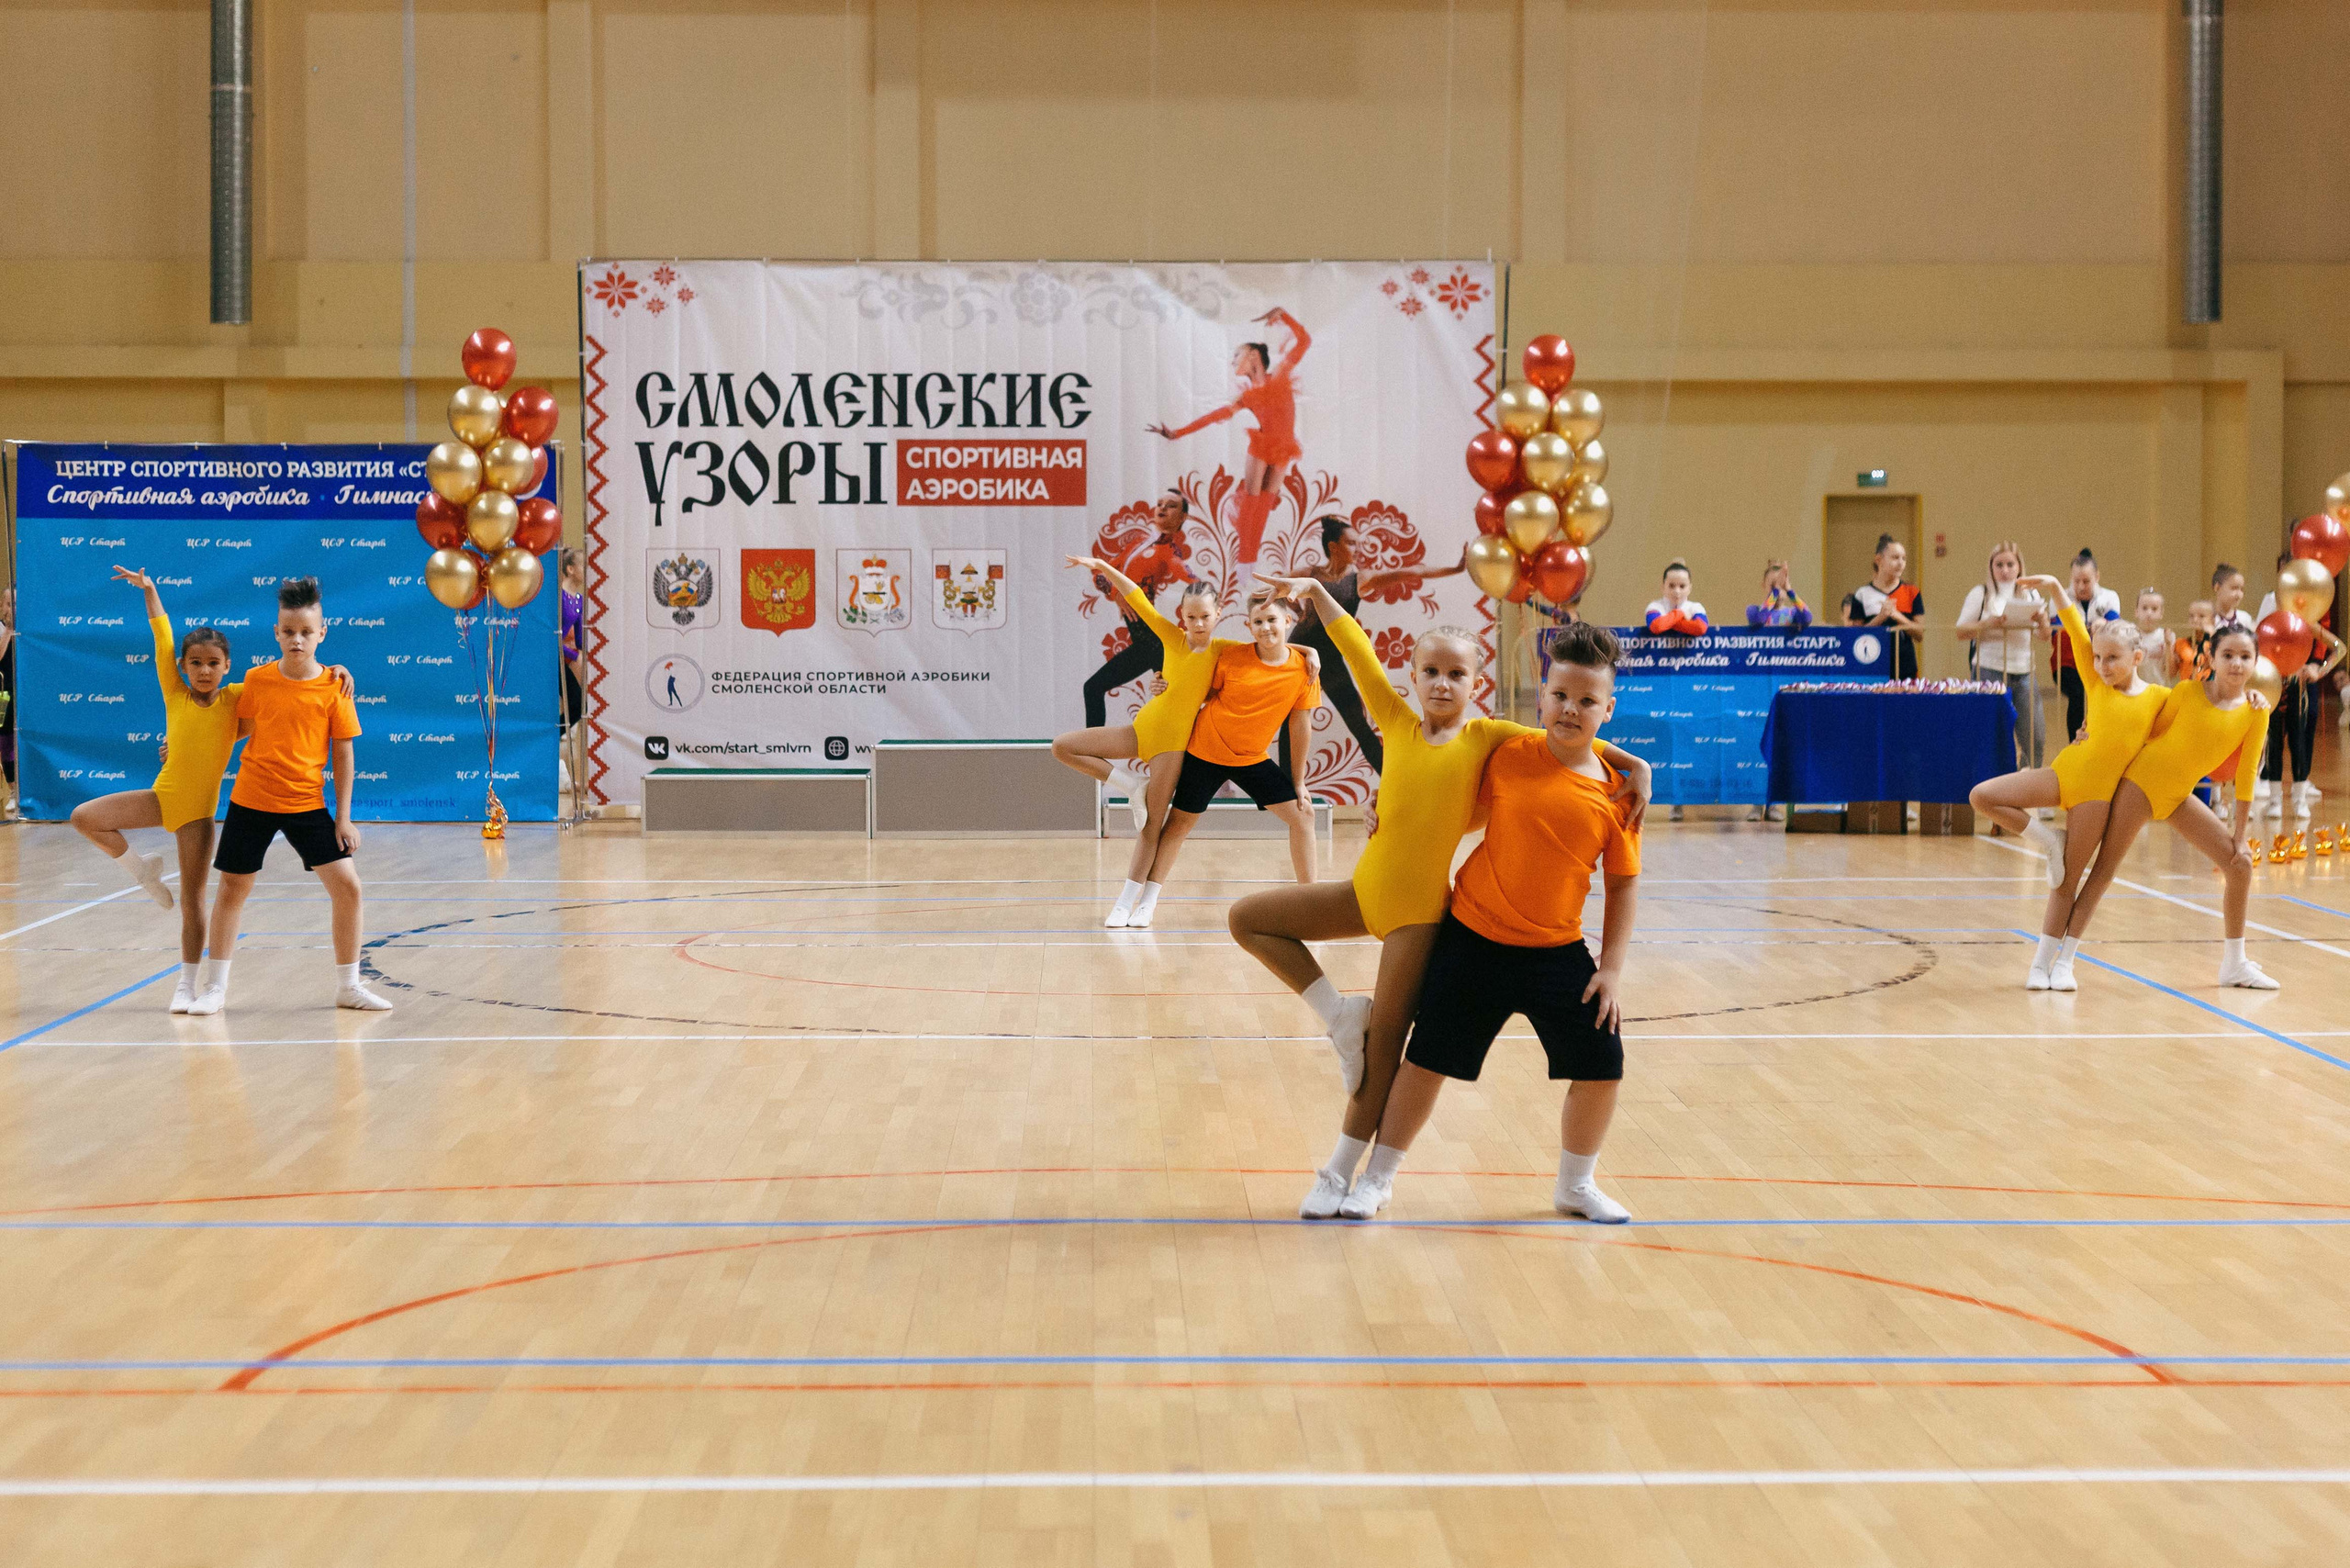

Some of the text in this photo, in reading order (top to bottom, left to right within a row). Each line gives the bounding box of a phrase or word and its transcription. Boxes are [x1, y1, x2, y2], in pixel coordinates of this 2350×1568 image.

[635, 371, 1092, 430] СМОЛЕНСКИЕ
[905, 446, 1083, 469] СПОРТИВНАЯ
[55, 460, 127, 480] ЦЕНТР
[130, 460, 283, 478] СПОРТИВНОГО
[286, 461, 395, 478] РАЗВИТИЯ
[633, 439, 889, 527] УЗОРЫ
[905, 477, 1050, 500] АЭРОБИКА
[47, 484, 196, 511] Спортивная
[200, 484, 310, 512] аэробика
[60, 536, 126, 549] ЦСР Старт
[185, 538, 252, 550] ЦСР Старт
[320, 537, 386, 550] ЦСР Старт
[155, 576, 193, 588] Старт
[58, 615, 124, 628] ЦСР Старт
[185, 617, 251, 629] ЦСР Старт
[348, 616, 386, 629] Старт
[1714, 635, 1785, 649] РАЗВИТИЯ
[1786, 635, 1841, 649] «СТАРТ»
[386, 655, 453, 666] ЦСР Старт
[1658, 652, 1730, 672] аэробика
[1745, 652, 1847, 667] Гимнастика
[711, 669, 990, 683] ФЕДЕРАЦИЯ СПОРТИВНОЙ АЭРОБИКИ
[711, 682, 887, 694] СМОЛЕНСКОЙ ОБЛАСТИ
[58, 693, 126, 705] ЦСР Старт
[388, 733, 455, 745] ЦСР Старт
[58, 769, 126, 781] ЦСР Старт
